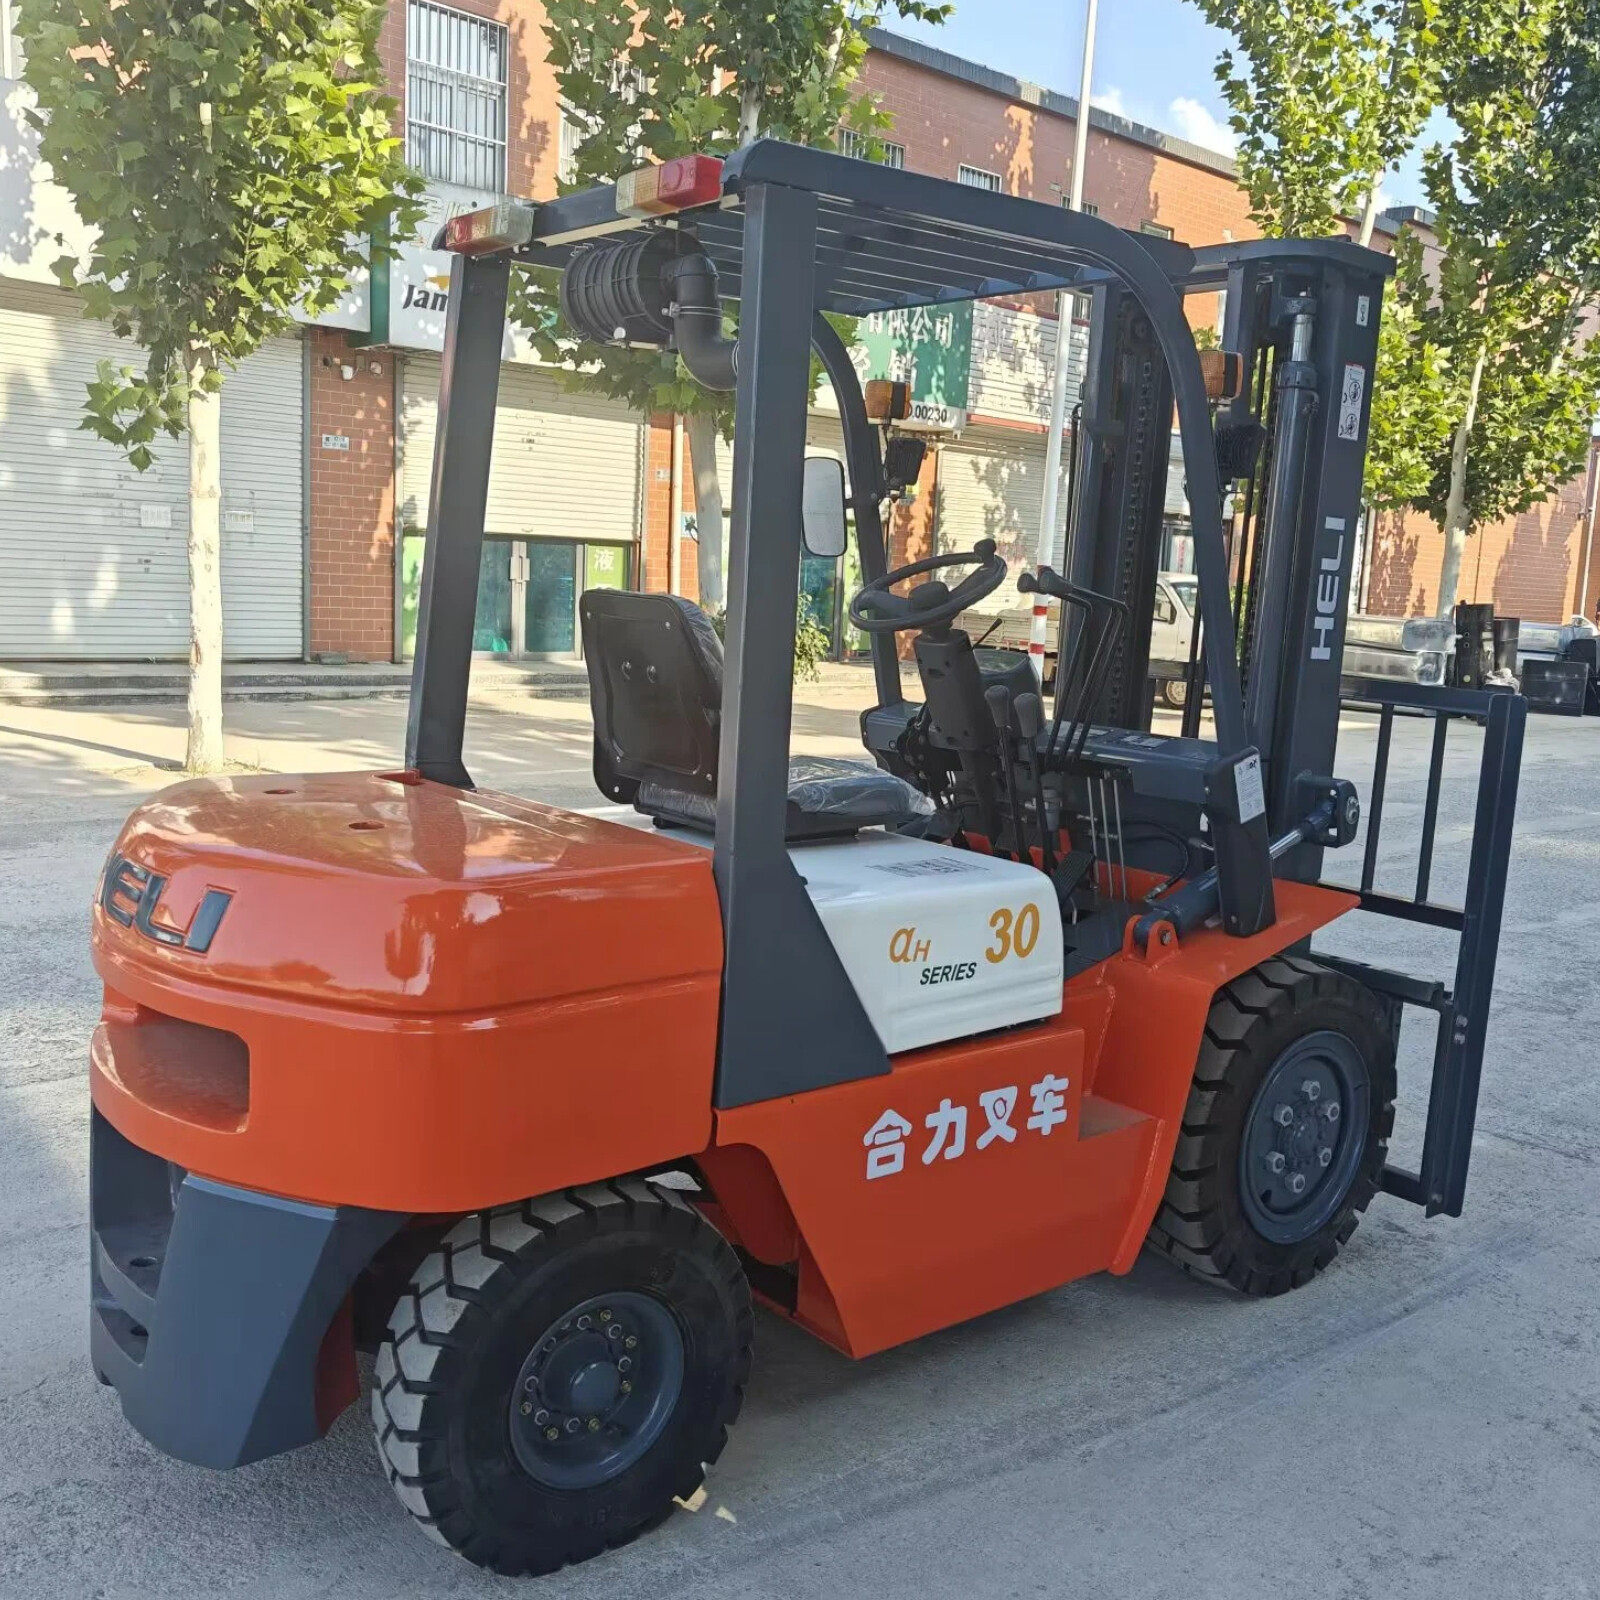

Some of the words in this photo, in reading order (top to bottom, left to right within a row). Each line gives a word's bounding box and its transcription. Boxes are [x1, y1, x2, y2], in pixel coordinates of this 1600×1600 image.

[907, 404, 947, 422] .00230
[1310, 516, 1346, 660] HELI
[101, 854, 233, 954] ELI
[985, 903, 1040, 964] 30
[919, 962, 977, 986] SERIES
[863, 1073, 1069, 1180] 合力叉车
